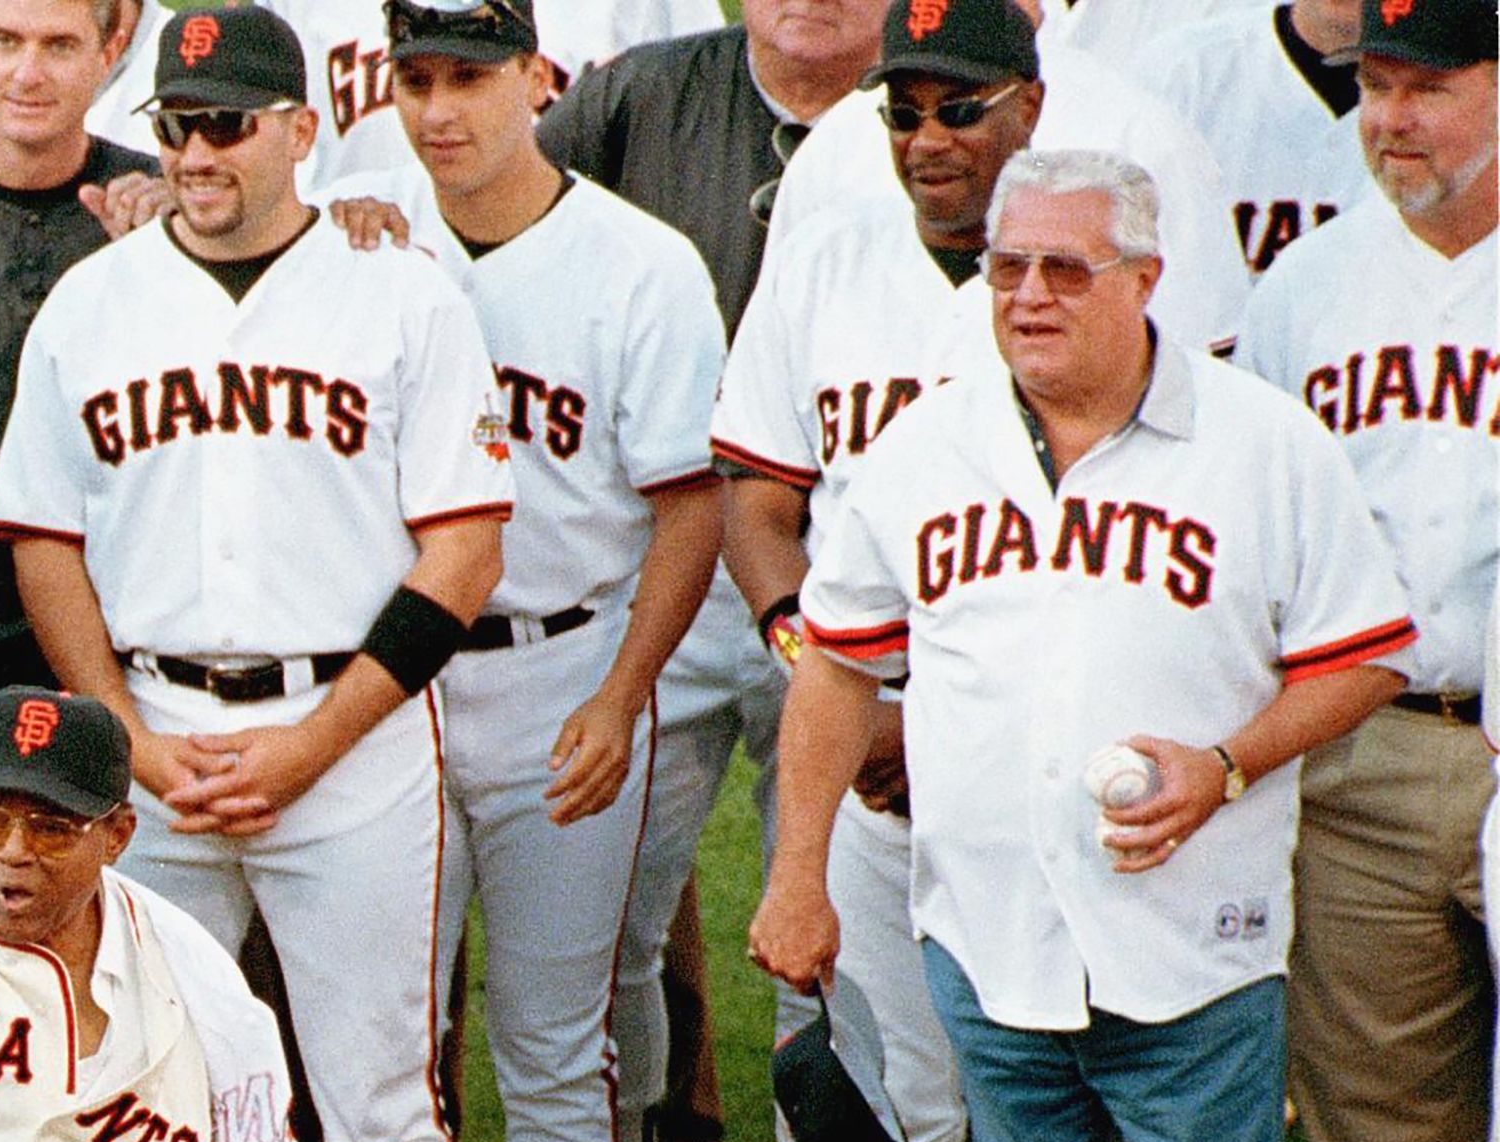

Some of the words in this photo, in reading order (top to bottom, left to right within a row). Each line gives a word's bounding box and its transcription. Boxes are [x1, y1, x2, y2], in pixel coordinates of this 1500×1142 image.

[80, 361, 369, 467] GIANTS
[916, 496, 1217, 610] GIANTS
[13, 699, 60, 756] SF
